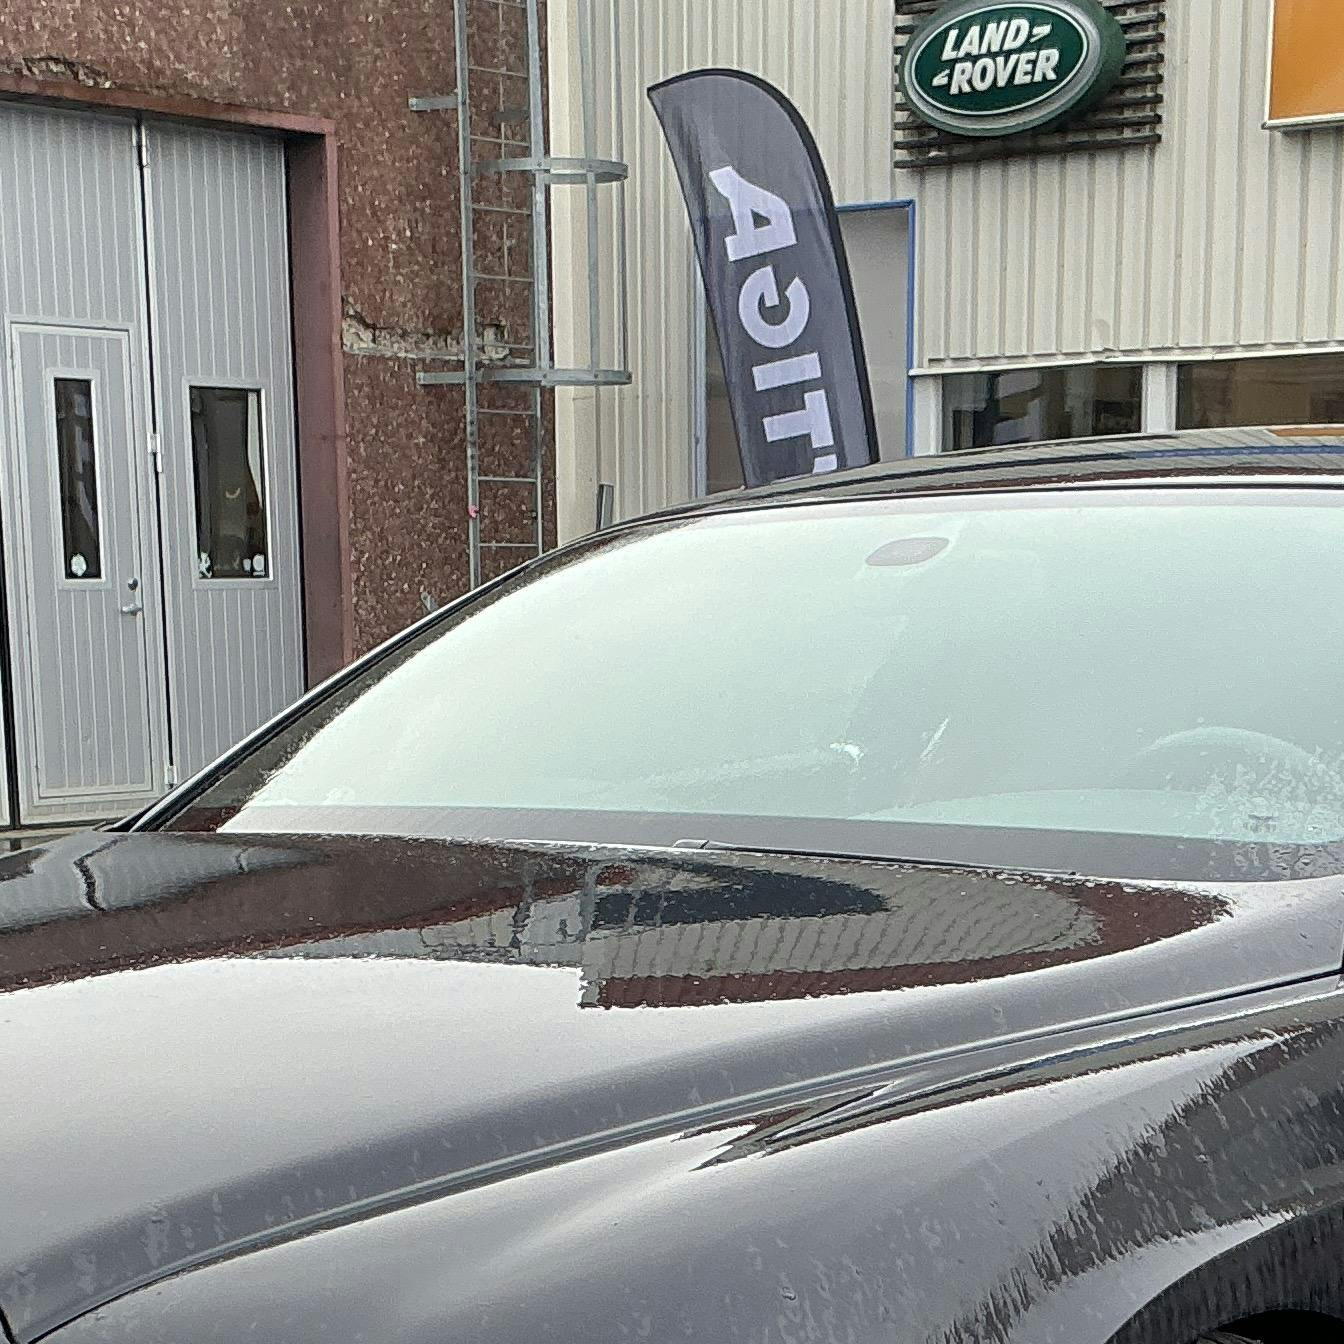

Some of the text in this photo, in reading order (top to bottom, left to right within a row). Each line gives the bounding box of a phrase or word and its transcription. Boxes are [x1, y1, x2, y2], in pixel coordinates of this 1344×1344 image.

[940, 18, 1030, 61] LAND
[949, 48, 1060, 95] ROVER
[709, 165, 838, 474] AGIT
